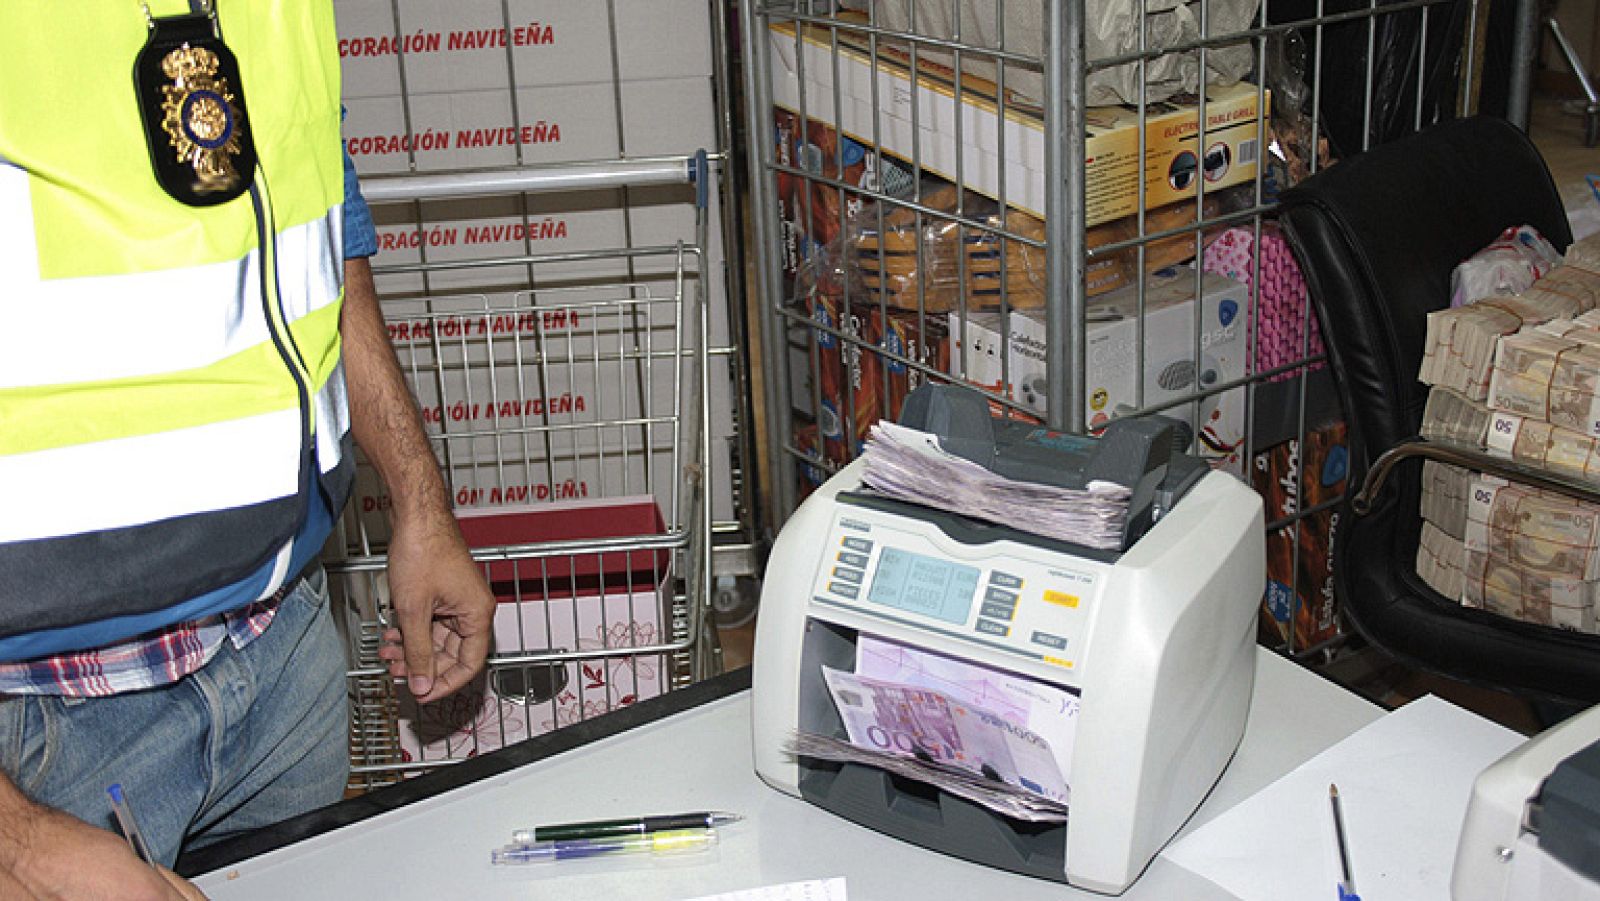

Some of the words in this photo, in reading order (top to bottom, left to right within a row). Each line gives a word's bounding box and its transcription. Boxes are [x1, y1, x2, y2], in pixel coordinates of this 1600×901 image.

[448, 22, 554, 51] NAVIDEÑA
[456, 120, 560, 149] NAVIDEÑA
[1164, 121, 1200, 138] ELECTRI
[464, 217, 568, 245] NAVIDEÑA
